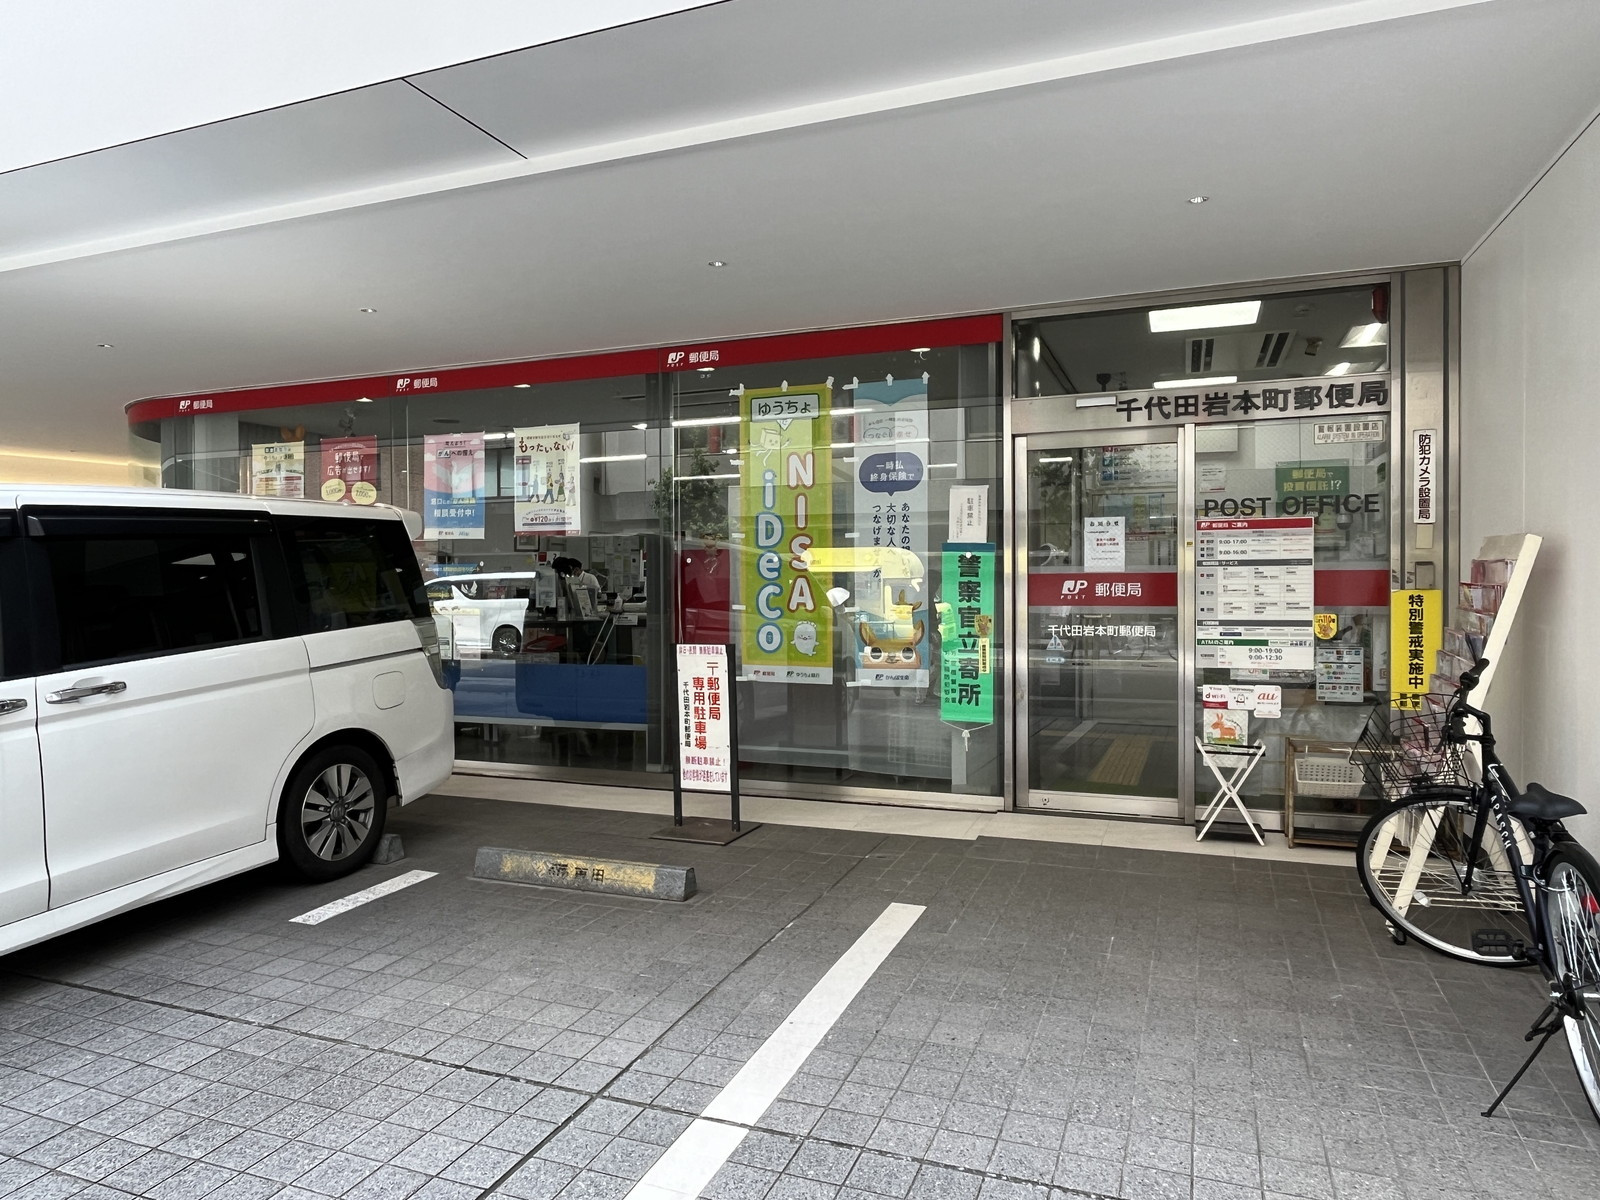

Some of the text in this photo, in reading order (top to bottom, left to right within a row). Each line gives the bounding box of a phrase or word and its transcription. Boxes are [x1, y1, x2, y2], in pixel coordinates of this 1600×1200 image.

[689, 350, 719, 364] 郵便局
[414, 378, 438, 389] 郵便局
[193, 400, 213, 410] 郵便局
[758, 400, 811, 416] ゆうちょ
[1116, 380, 1389, 422] 千代田岩本町郵便局
[876, 460, 904, 470] 一時払
[870, 472, 914, 482] 終身保険で
[1418, 434, 1432, 520] 防犯カメラ設置局
[1204, 493, 1380, 517] POST OFFICE
[787, 452, 815, 612] NISA
[756, 470, 784, 653] iDeCo
[1095, 582, 1142, 596] 郵便局
[958, 554, 981, 706] 警察官立寄所
[1048, 624, 1156, 637] 千代田岩本町郵便局
[1408, 594, 1424, 690] 特別警戒実施中
[1258, 692, 1278, 700] au
[683, 681, 691, 748] 千代田岩本町郵便局
[692, 676, 707, 750] 専用駐車場
